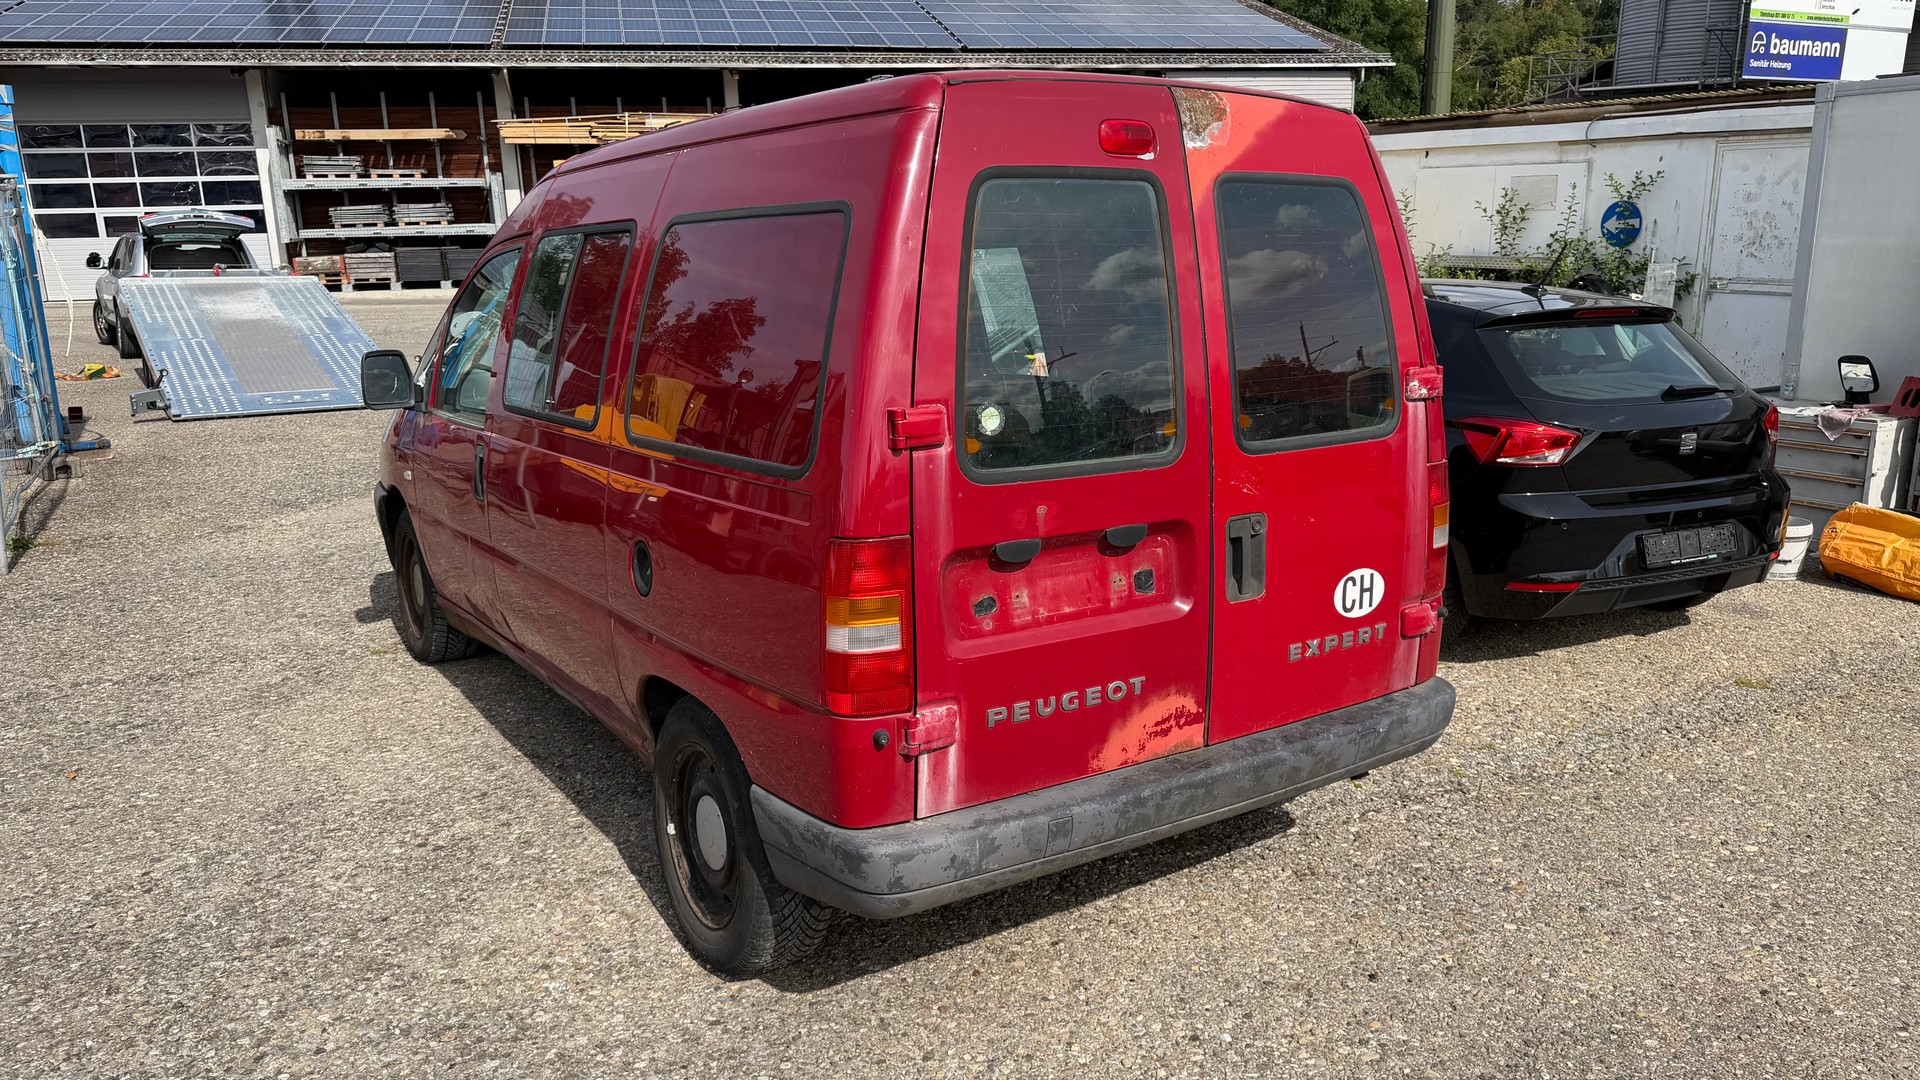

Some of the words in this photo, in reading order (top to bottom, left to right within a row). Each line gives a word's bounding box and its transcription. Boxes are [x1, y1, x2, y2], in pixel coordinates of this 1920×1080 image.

[1750, 59, 1769, 68] Sanitär
[1770, 60, 1792, 70] Heizung
[1770, 33, 1840, 57] baumann
[1342, 573, 1374, 613] CH
[1288, 623, 1387, 662] EXPERT
[986, 676, 1146, 729] PEUGEOT
